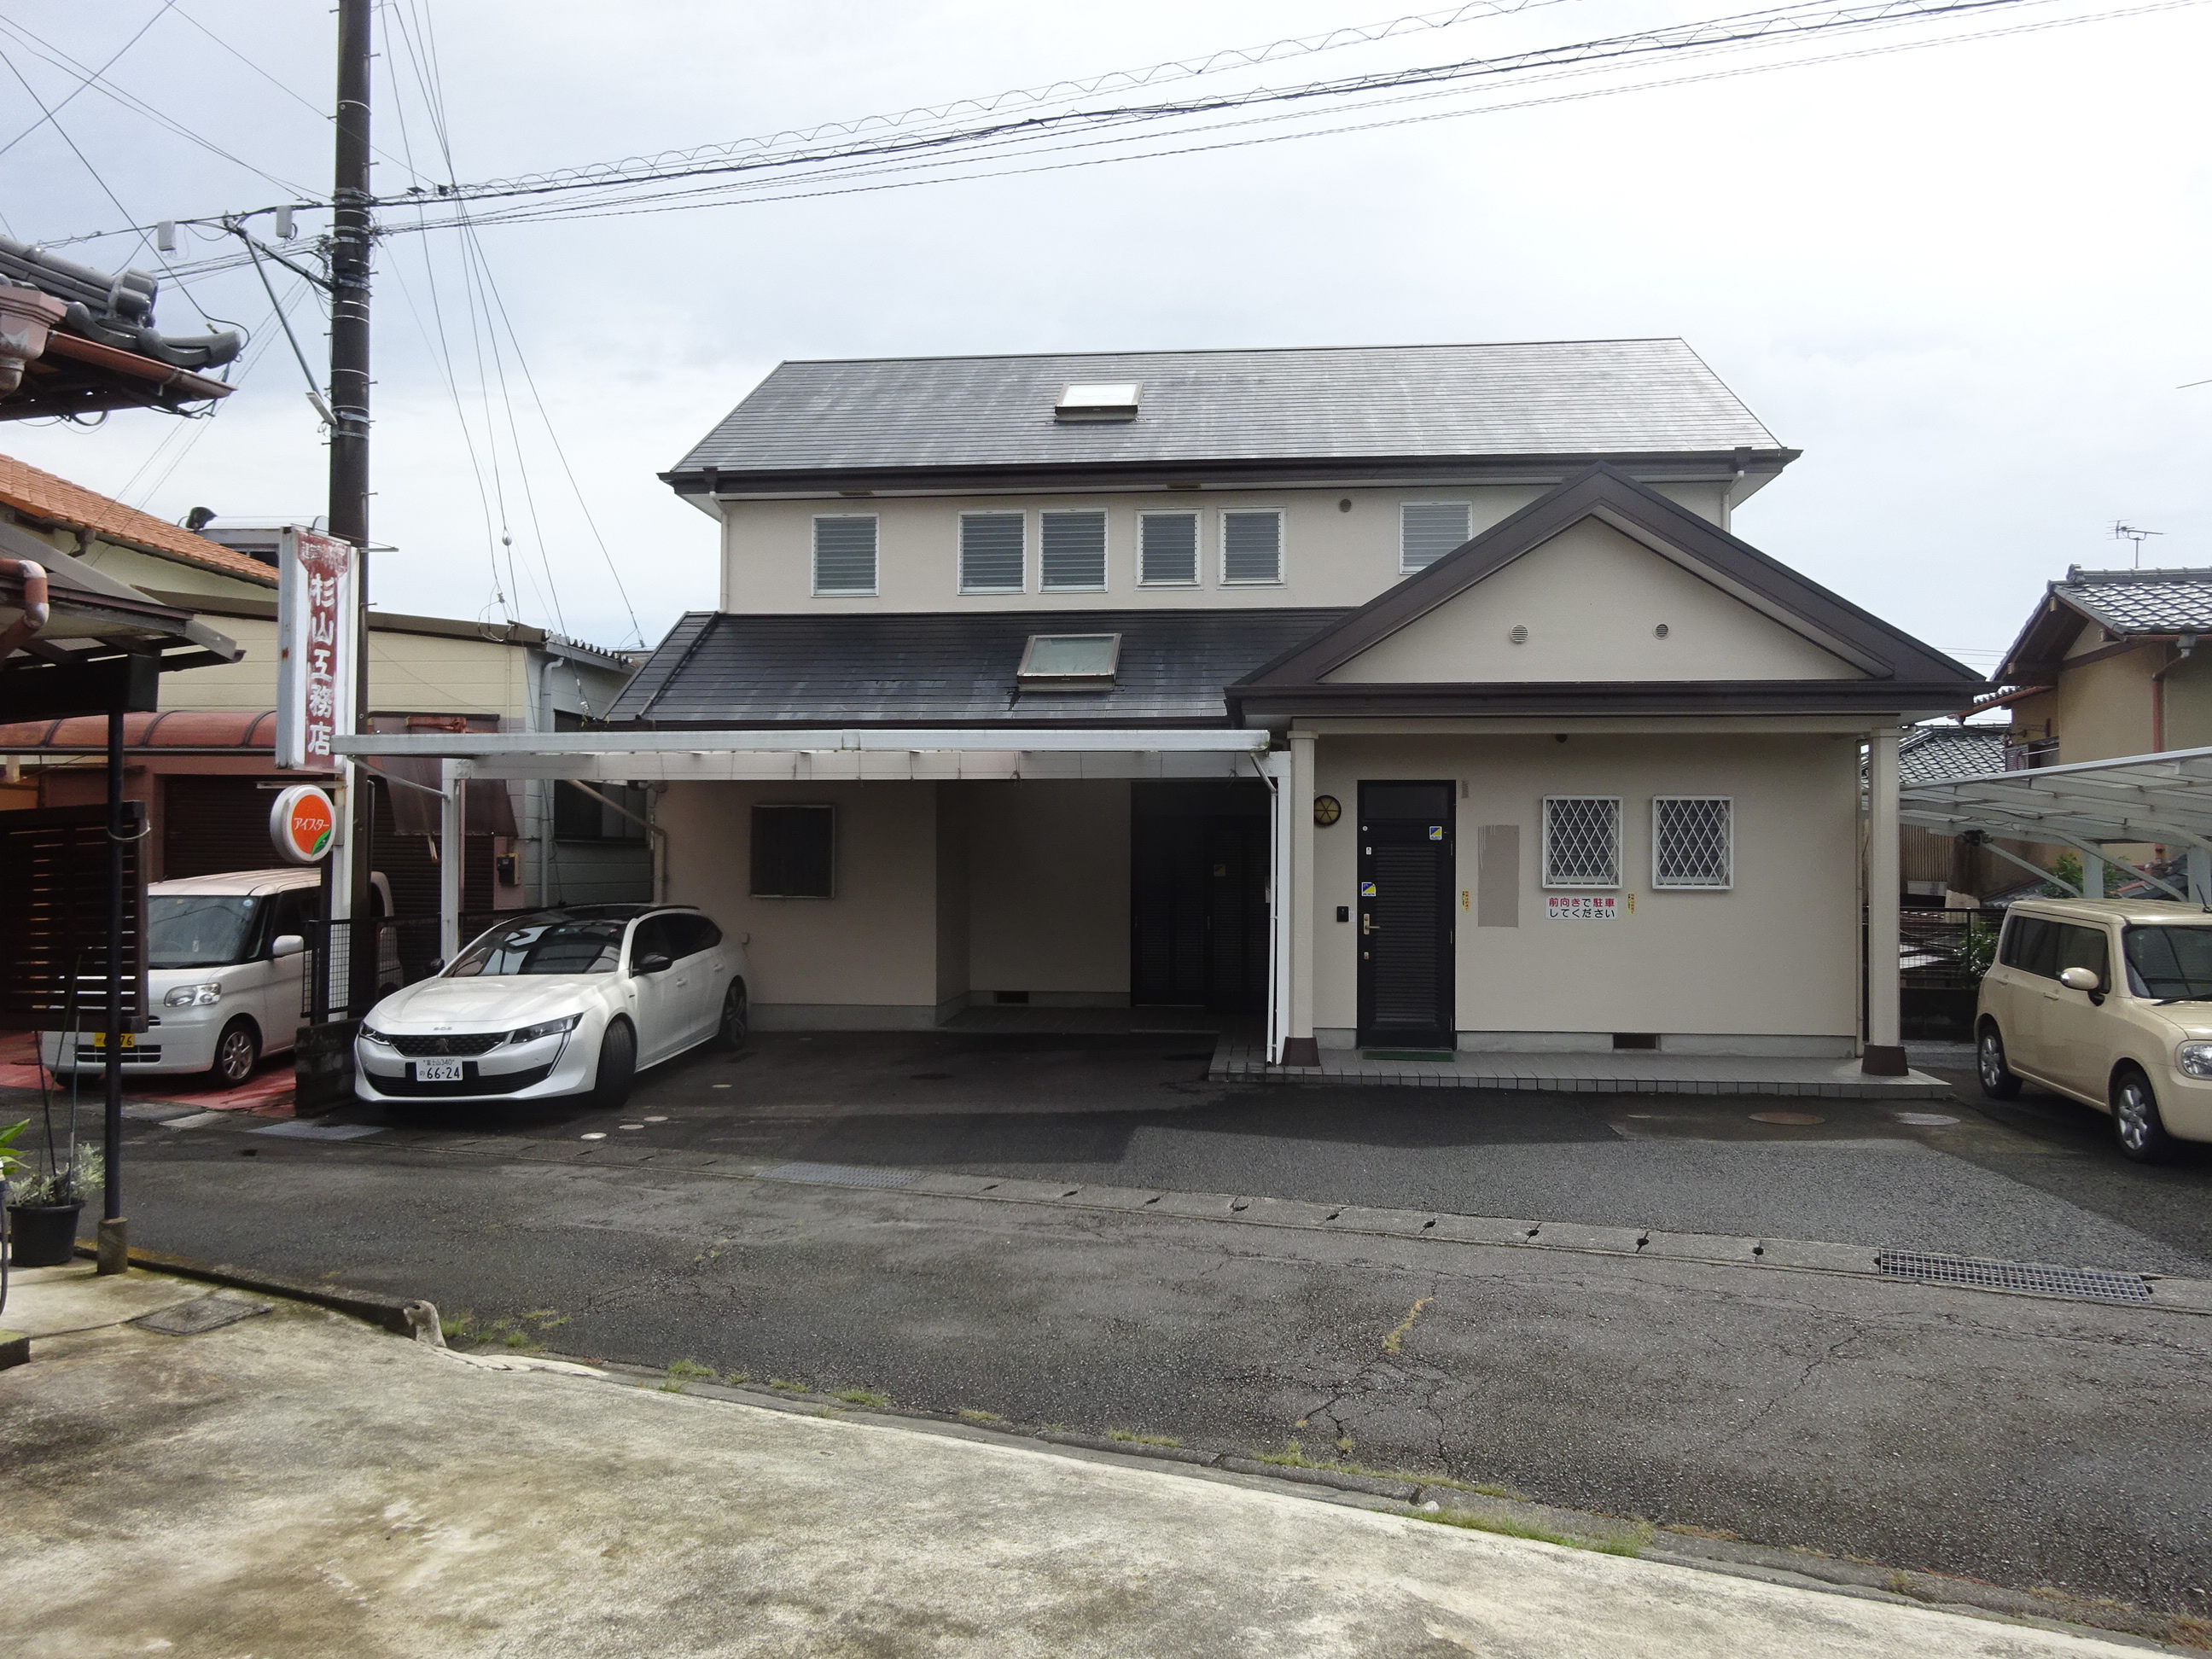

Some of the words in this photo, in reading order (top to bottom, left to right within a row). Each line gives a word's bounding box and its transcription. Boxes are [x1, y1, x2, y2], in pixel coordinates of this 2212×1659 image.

[308, 573, 335, 755] 杉山工務店
[294, 818, 329, 830] アイスター
[1549, 898, 1615, 907] 前向きで駐車
[1550, 908, 1615, 918] してください
[427, 1067, 460, 1079] 66-24
